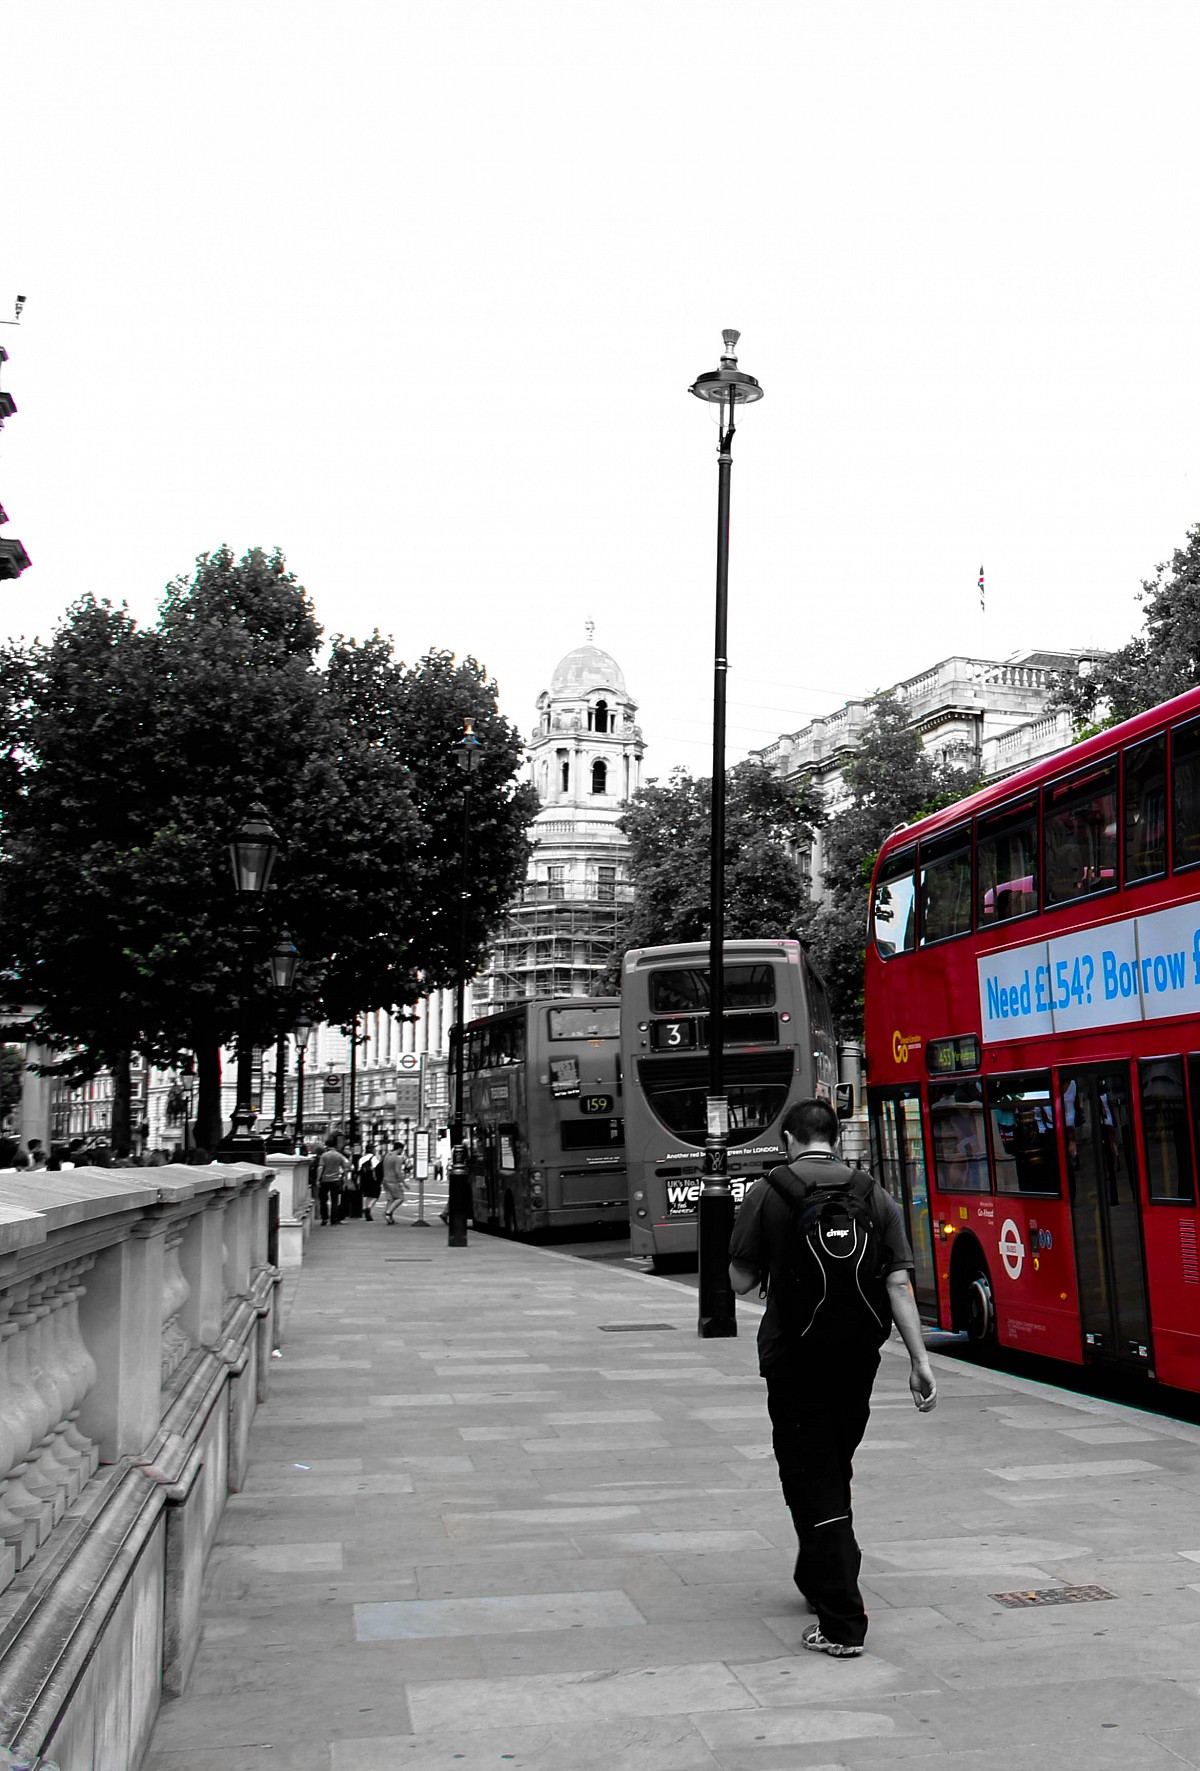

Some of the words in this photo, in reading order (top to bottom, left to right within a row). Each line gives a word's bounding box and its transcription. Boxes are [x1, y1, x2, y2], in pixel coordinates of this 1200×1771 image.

[986, 969, 1032, 1020] Need
[1034, 953, 1095, 1013] £154?
[1101, 950, 1186, 1001] Borrow
[666, 1024, 681, 1045] 3
[893, 1030, 908, 1063] Go
[586, 1098, 607, 1112] 159
[666, 1152, 689, 1160] Another
[690, 1151, 700, 1159] red
[753, 1146, 779, 1154] LONDON
[667, 1180, 684, 1188] UK's
[684, 1179, 700, 1187] No.1
